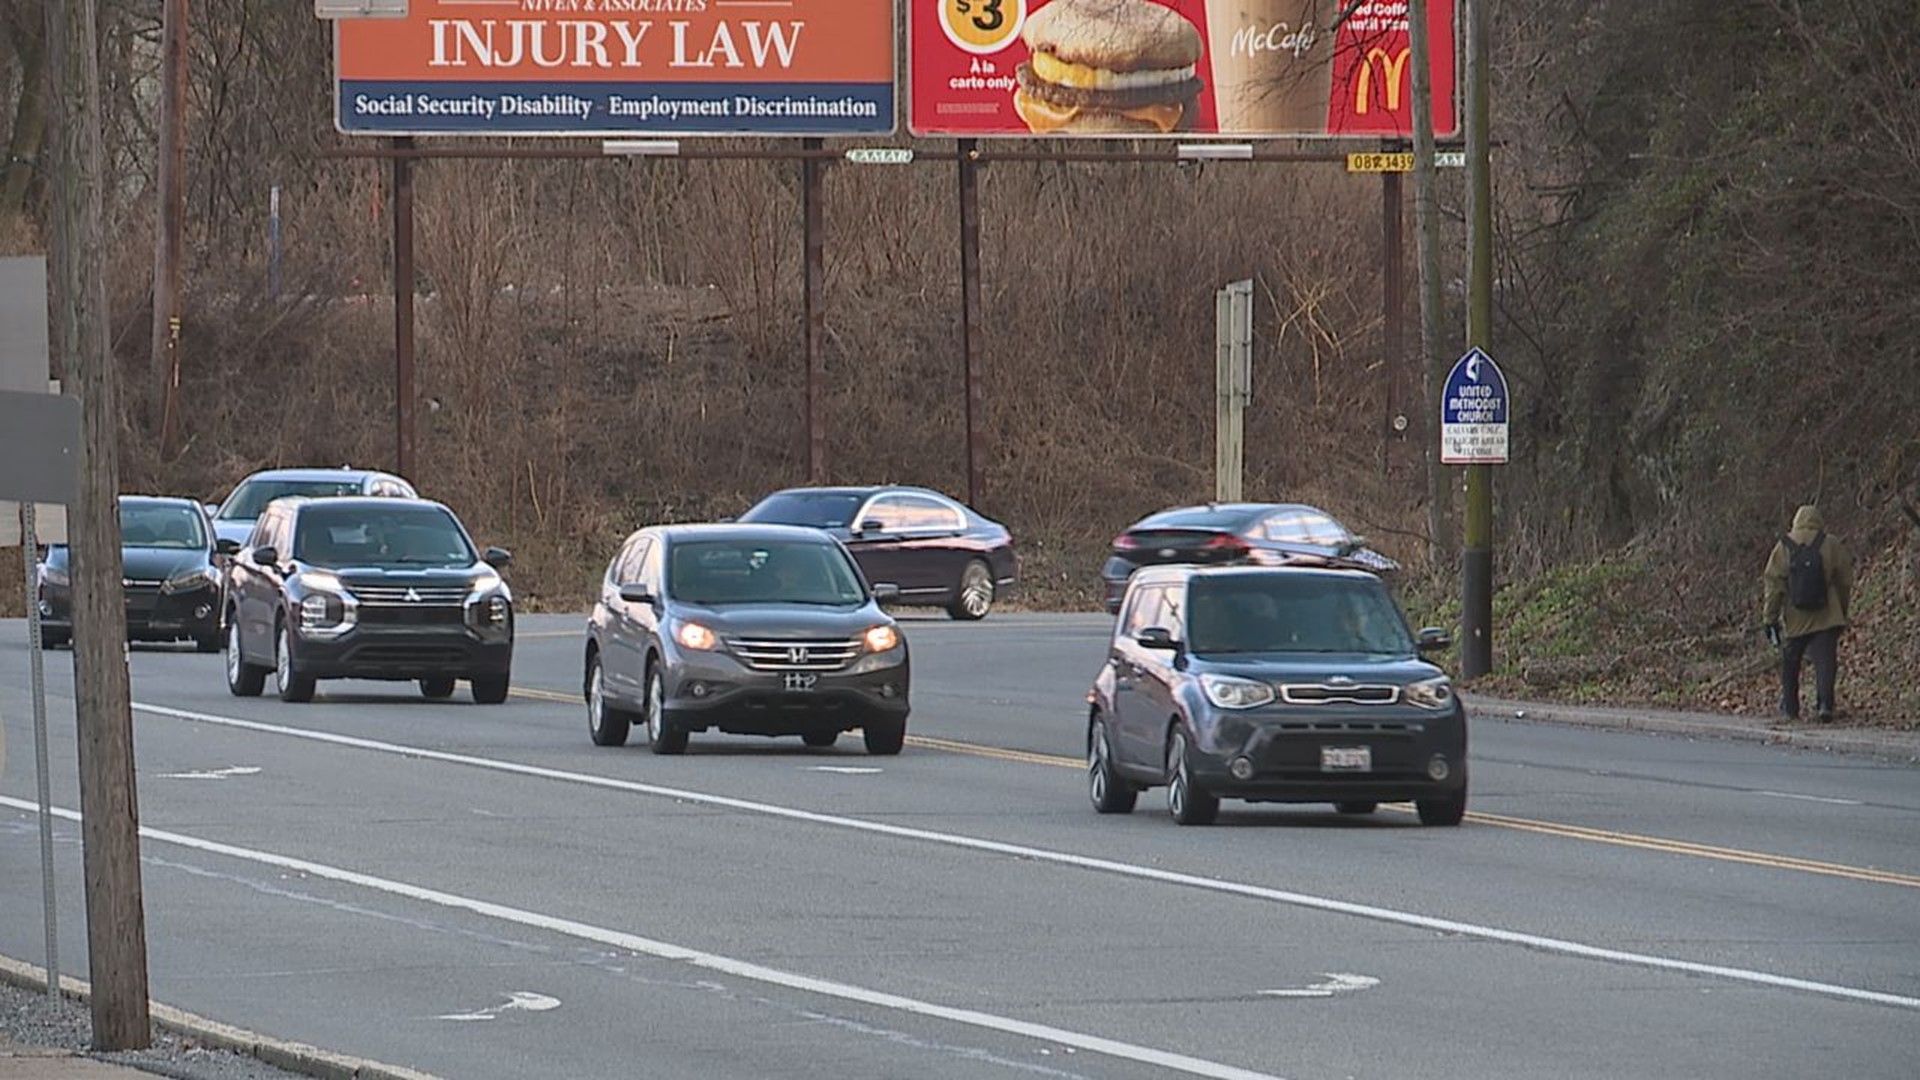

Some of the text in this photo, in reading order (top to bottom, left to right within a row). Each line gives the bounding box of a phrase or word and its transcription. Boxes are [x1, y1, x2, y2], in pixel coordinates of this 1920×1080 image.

[521, 0, 707, 12] NIVEN & ASSOCIATES
[428, 19, 805, 68] INJURY LAW
[982, 60, 996, 74] la
[949, 75, 1016, 92] carte only
[355, 94, 877, 120] Social Security Disability Employment Discrimination
[1458, 385, 1493, 398] UNITED
[1449, 398, 1501, 410] METHODIST
[1457, 410, 1494, 422] CHURCH
